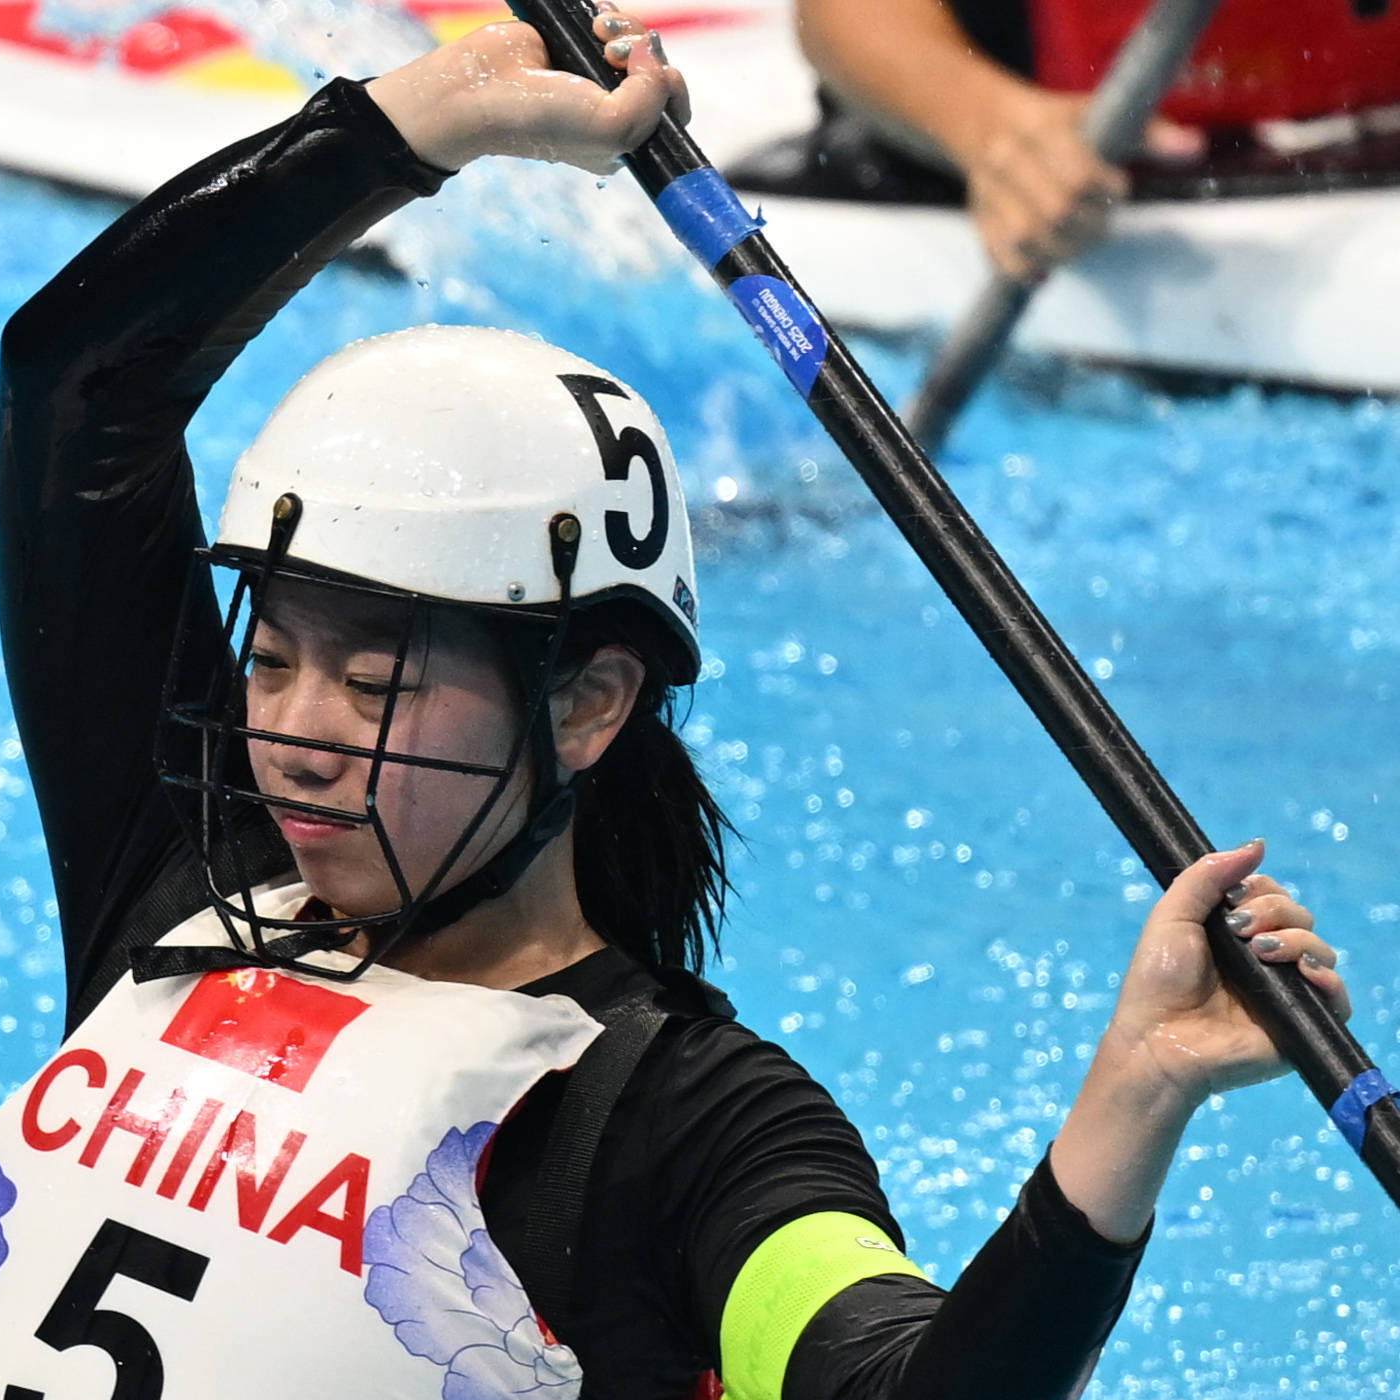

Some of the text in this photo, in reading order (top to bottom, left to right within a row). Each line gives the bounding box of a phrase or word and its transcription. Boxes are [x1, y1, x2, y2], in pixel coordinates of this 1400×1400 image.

[758, 287, 814, 354] 2025 CHENGDU
[555, 374, 669, 569] 5
[22, 1047, 372, 1277] CHINA
